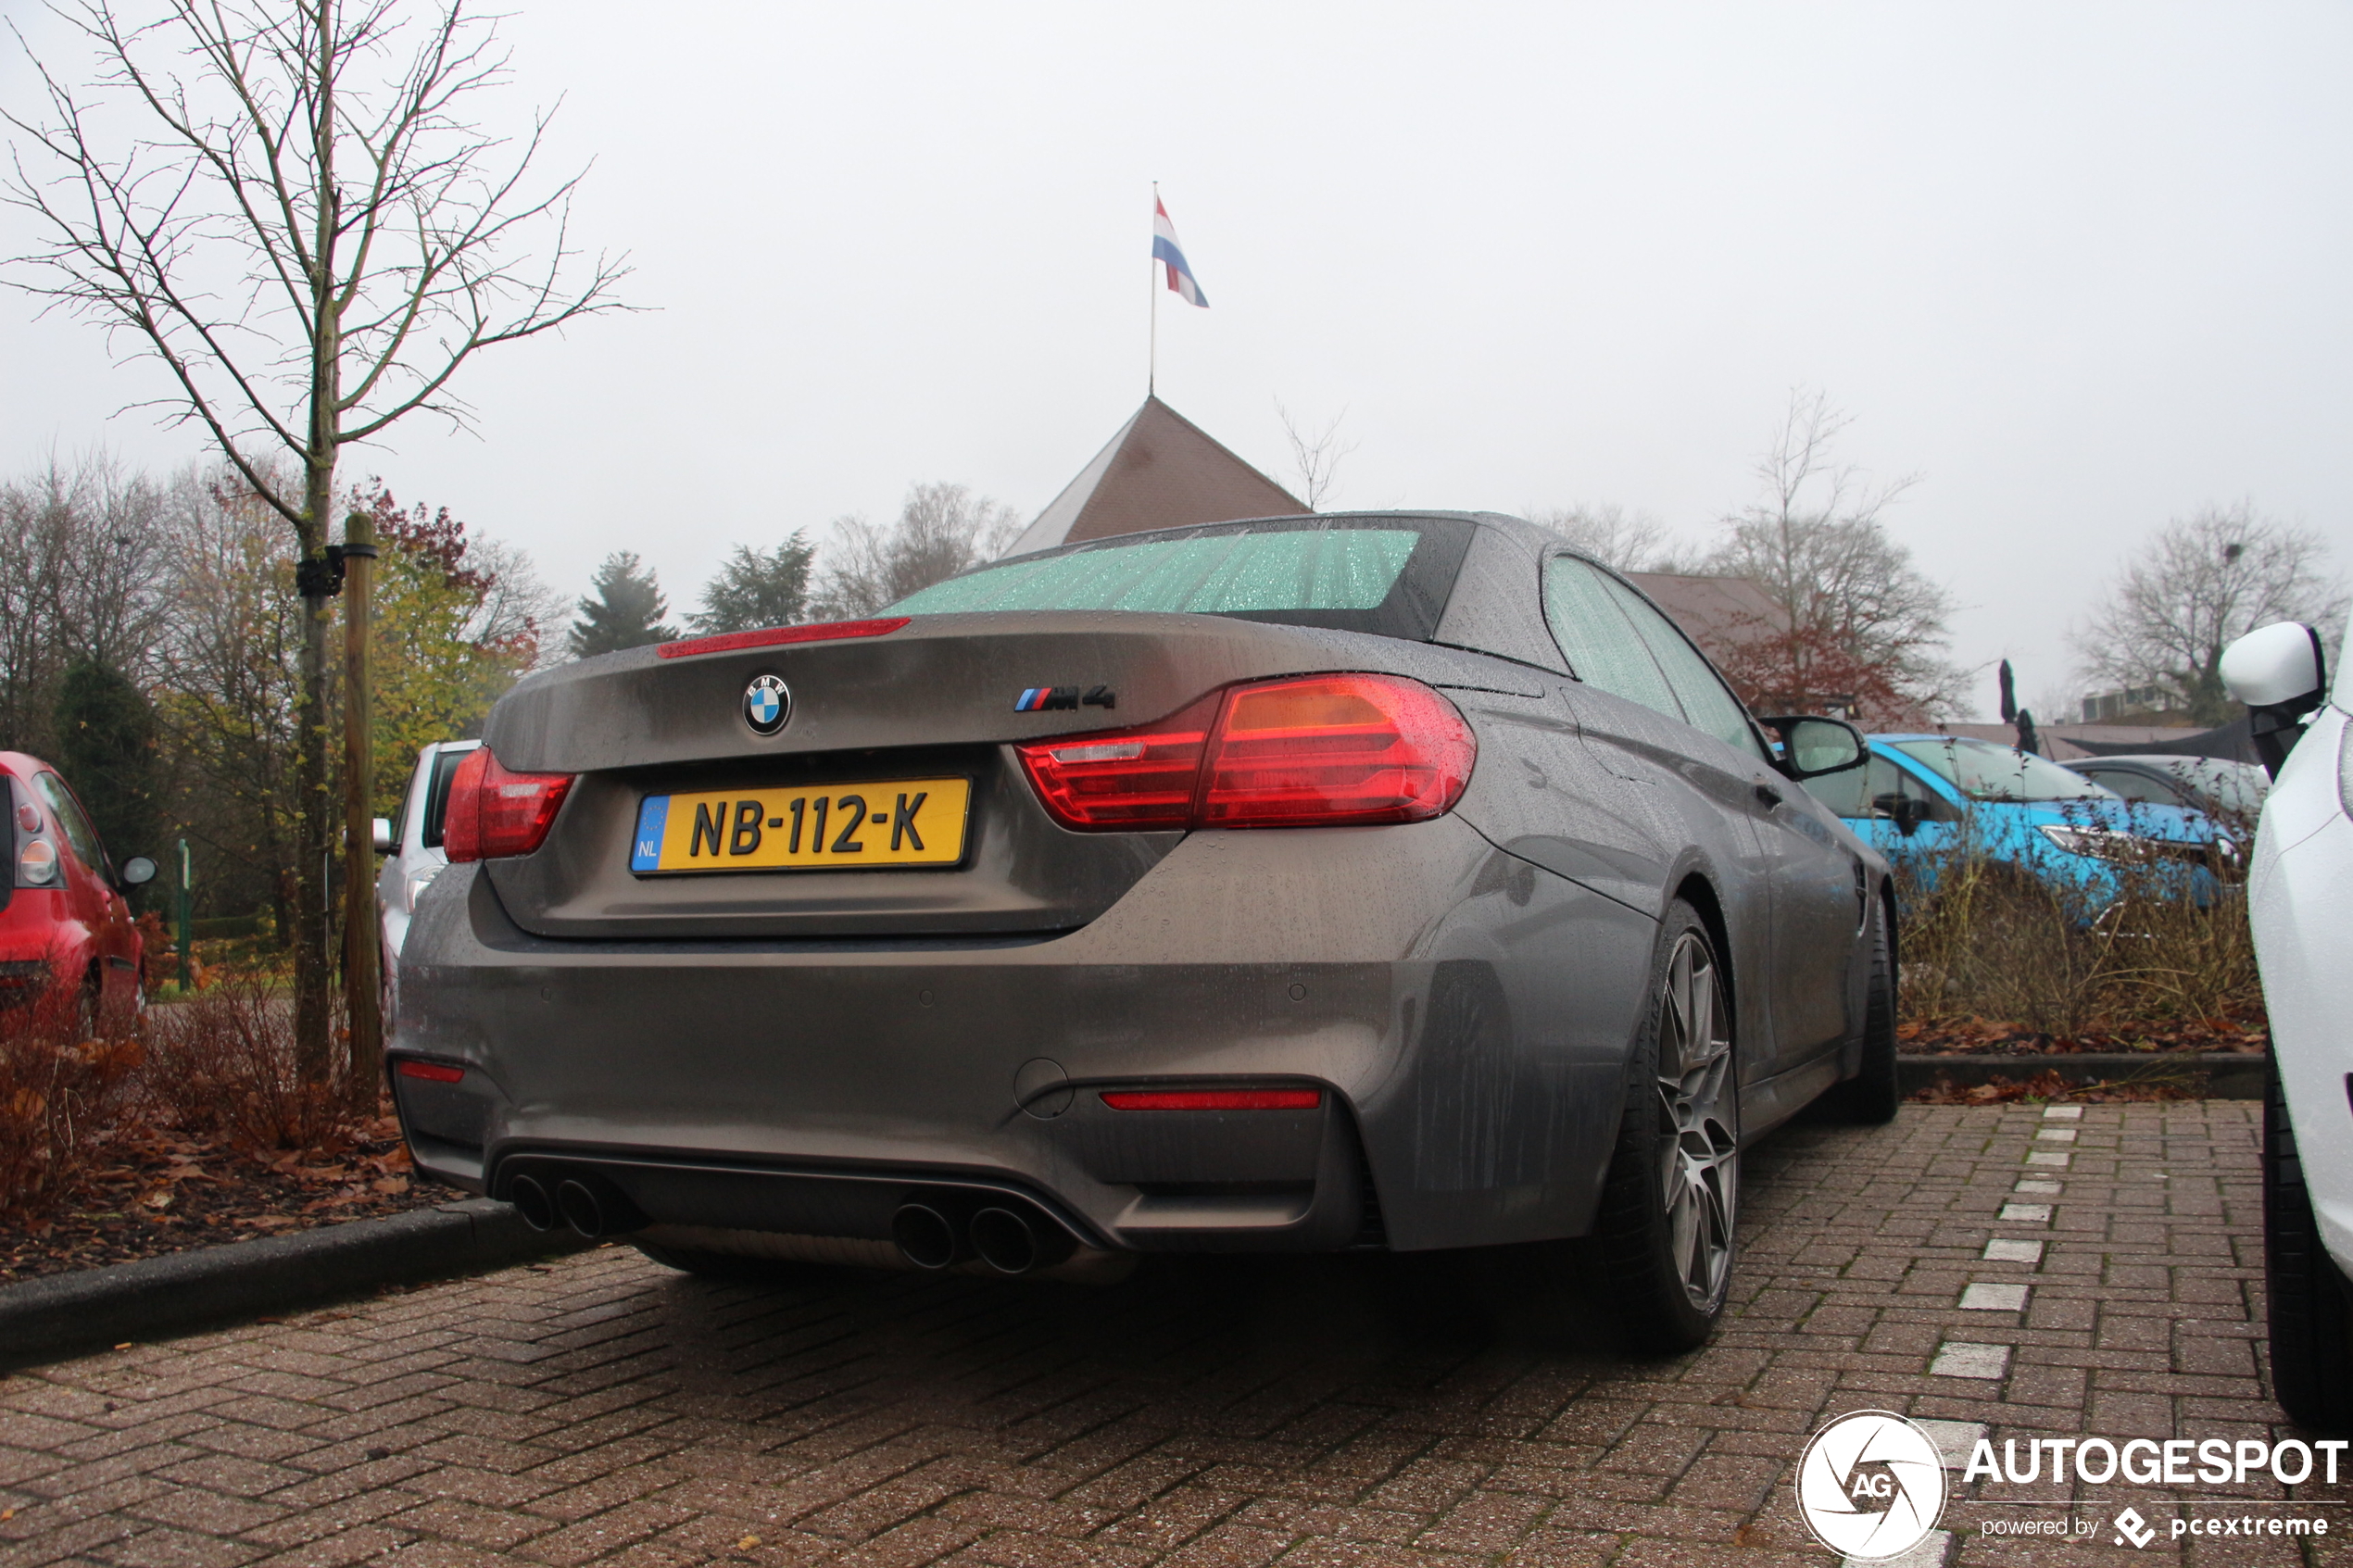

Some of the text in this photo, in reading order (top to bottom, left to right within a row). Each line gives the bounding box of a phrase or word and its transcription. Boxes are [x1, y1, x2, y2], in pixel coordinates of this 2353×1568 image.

[747, 677, 786, 696] BMW
[689, 792, 928, 857] NB-112-K
[638, 840, 658, 858] NL
